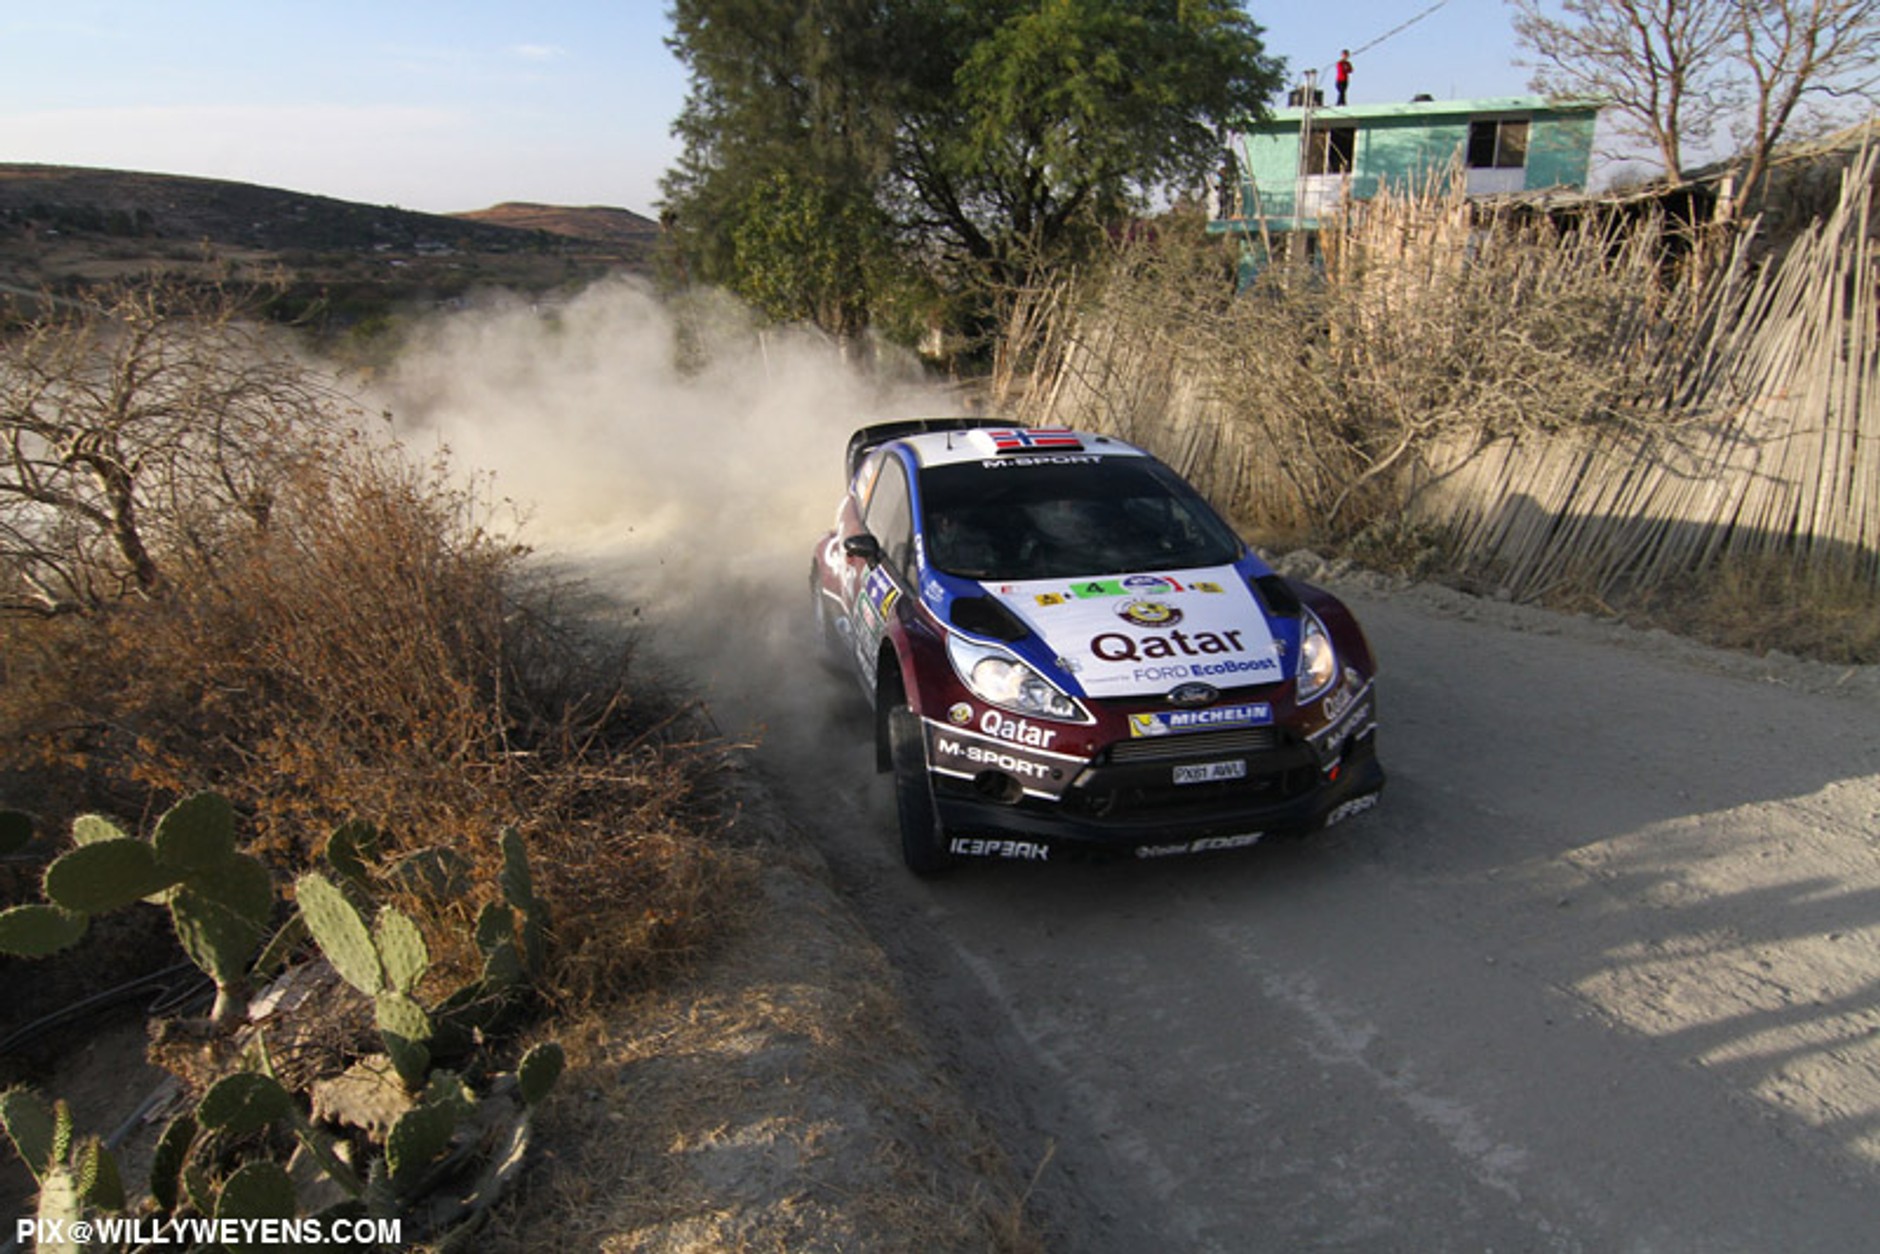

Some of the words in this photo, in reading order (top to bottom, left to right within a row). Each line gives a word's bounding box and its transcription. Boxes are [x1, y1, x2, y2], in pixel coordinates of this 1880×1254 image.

[1086, 582, 1105, 593] 4
[1090, 629, 1246, 662] Qatar
[1133, 664, 1188, 682] FORD
[1190, 657, 1277, 678] EcoBoost
[980, 709, 1057, 748] Qatar
[1170, 706, 1268, 725] MICHELIN
[939, 738, 1050, 779] M-SPORT
